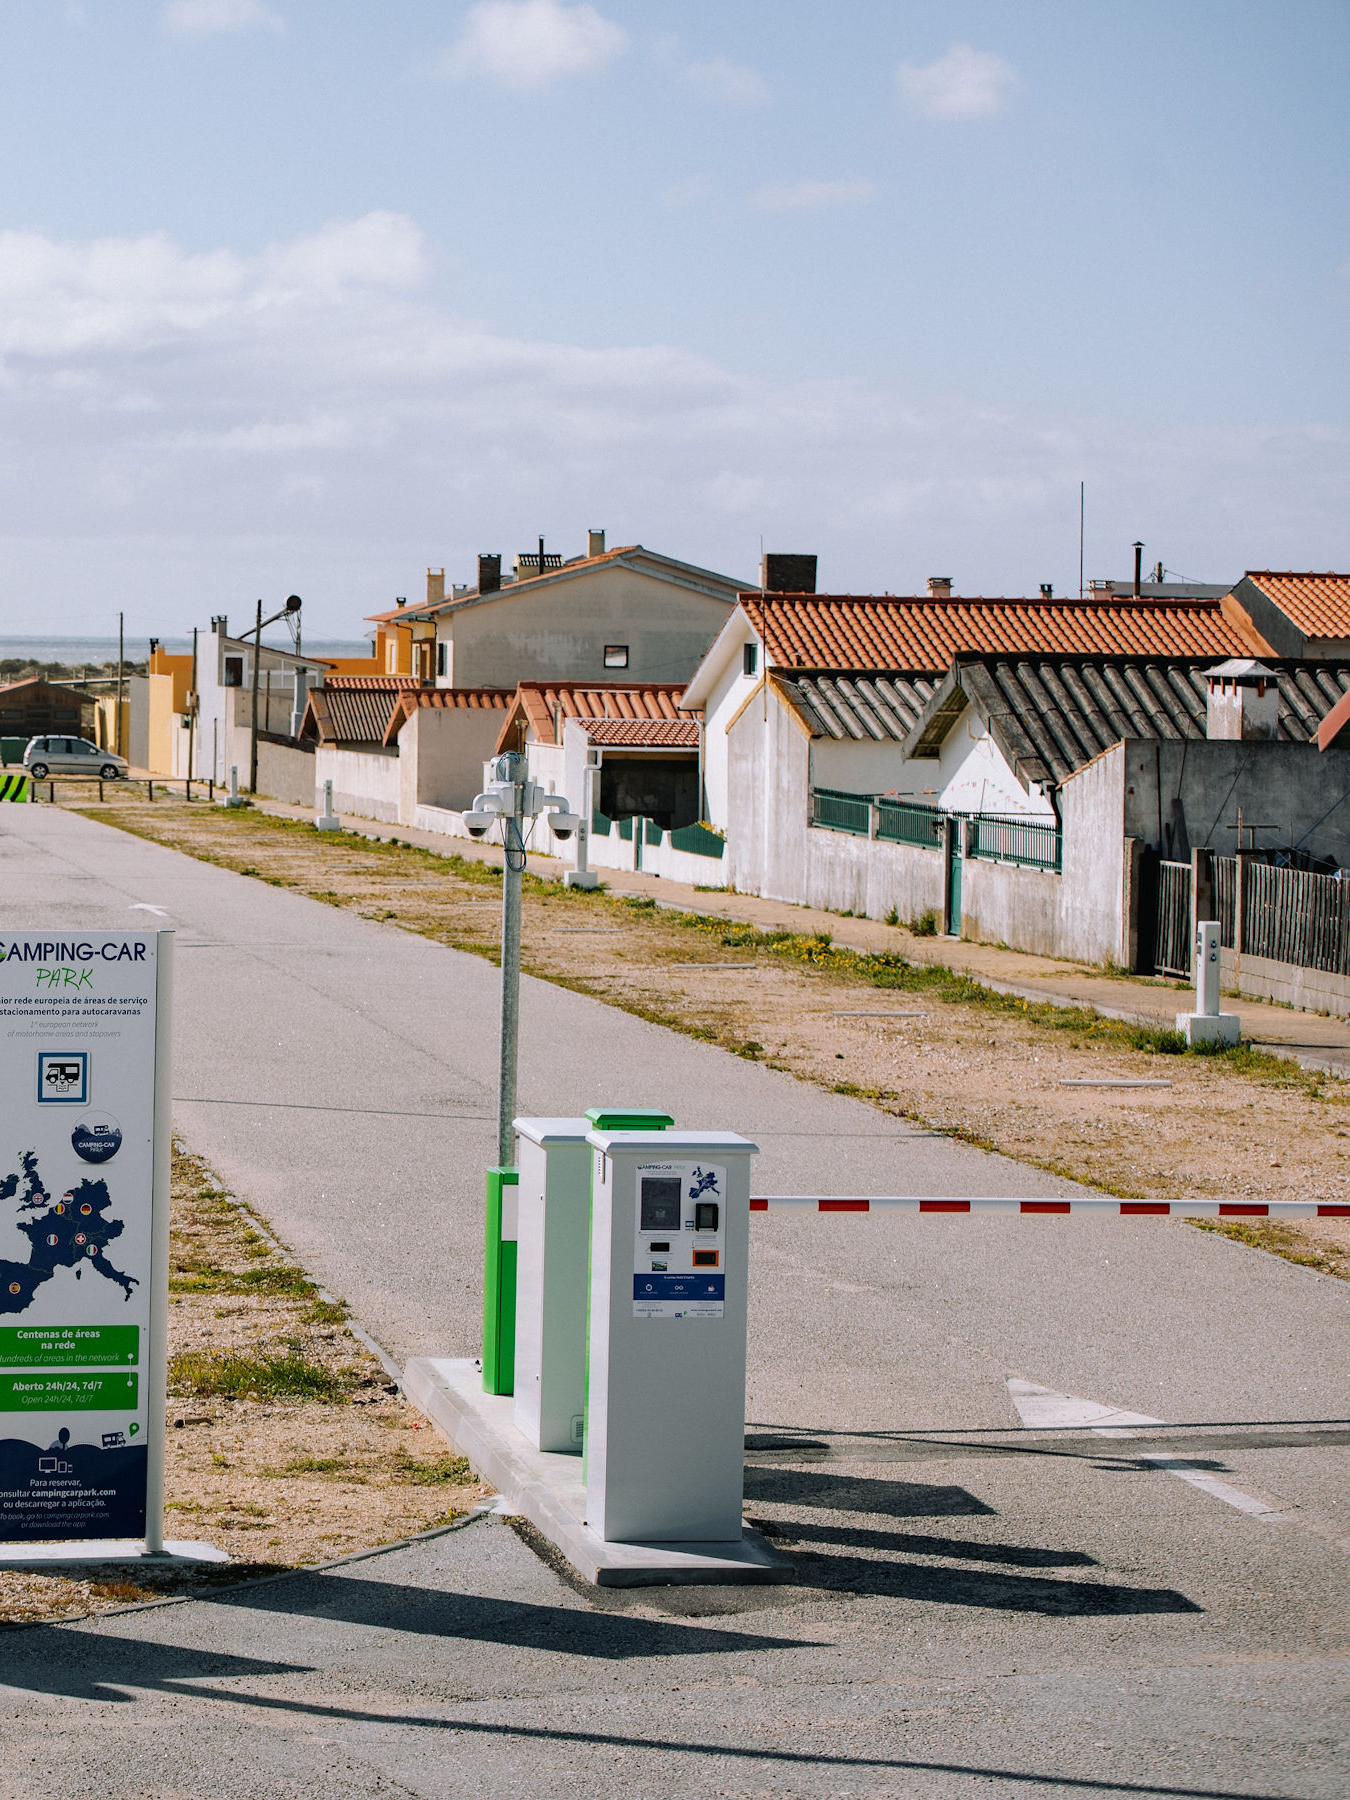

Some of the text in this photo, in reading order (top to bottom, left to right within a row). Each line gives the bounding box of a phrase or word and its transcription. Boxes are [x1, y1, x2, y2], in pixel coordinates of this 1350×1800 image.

[36, 967, 93, 990] PARK
[14, 997, 33, 1005] rede
[34, 997, 71, 1006] europeia
[72, 997, 82, 1005] de
[84, 996, 106, 1005] áreas
[108, 997, 117, 1005] de
[119, 997, 148, 1006] serviço
[39, 1022, 70, 1030] european
[7, 1030, 14, 1038] of
[90, 1030, 121, 1038] stopovers
[17, 1329, 101, 1339] Centenas de áreas
[54, 1340, 76, 1349] rede
[34, 1354, 42, 1364] of
[66, 1354, 74, 1362] in
[75, 1354, 88, 1362] the
[89, 1353, 120, 1361] network
[12, 1381, 103, 1392] Aberto 24h/24, 7d/7
[21, 1394, 94, 1405] Open 24h/24, 7d/7
[29, 1479, 82, 1488] Para reservar,
[31, 1488, 116, 1499] campingcarpark.com
[15, 1500, 60, 1509] descarregar
[68, 1498, 107, 1509] aplicação.
